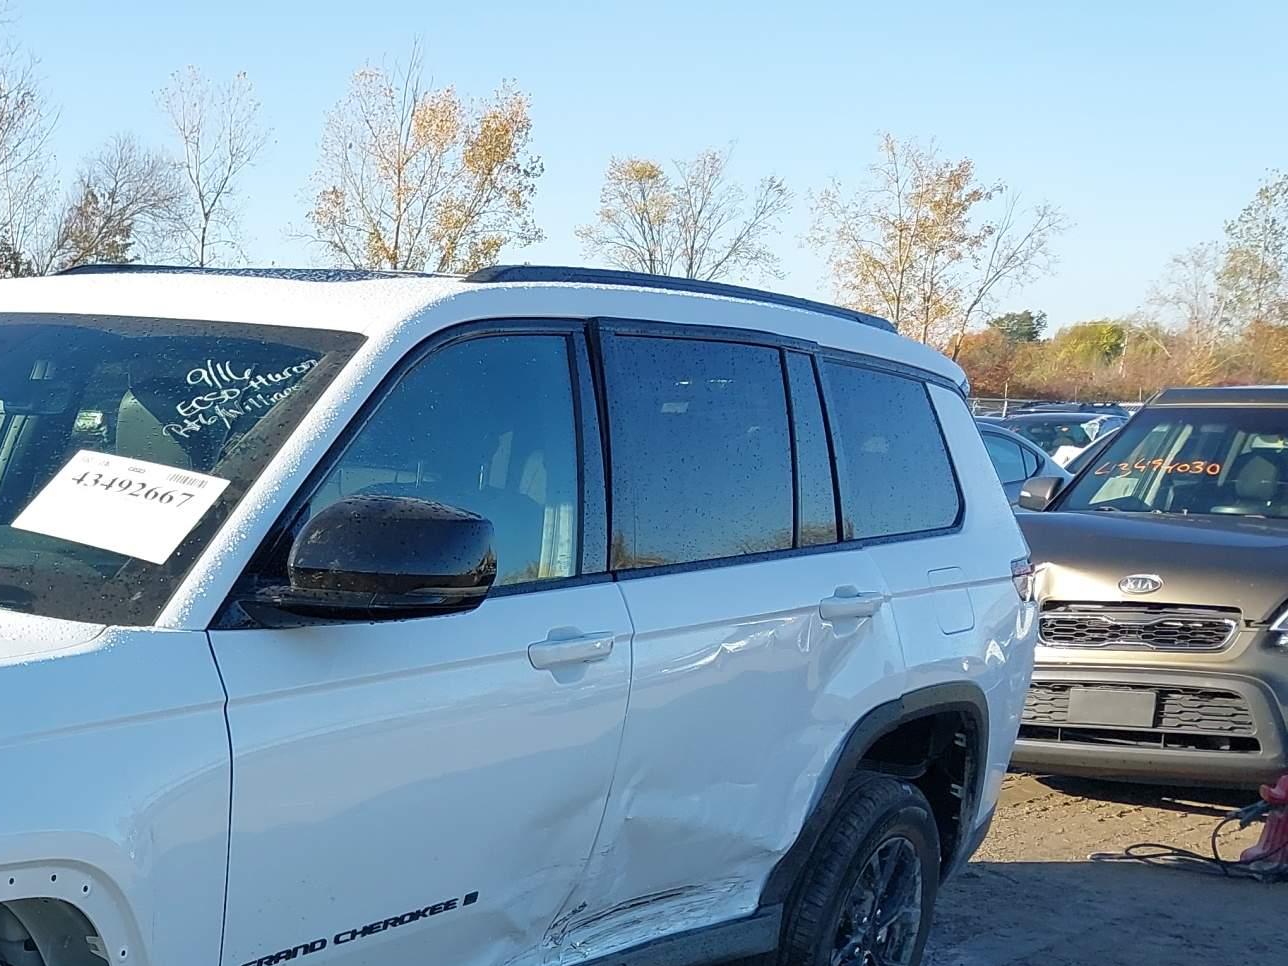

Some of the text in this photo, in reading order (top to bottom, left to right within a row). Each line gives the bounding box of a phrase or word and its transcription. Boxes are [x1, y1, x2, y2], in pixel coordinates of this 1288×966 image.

[186, 359, 252, 390] 9/16
[72, 470, 195, 508] 43492667
[333, 898, 460, 946] CHEROKEE
